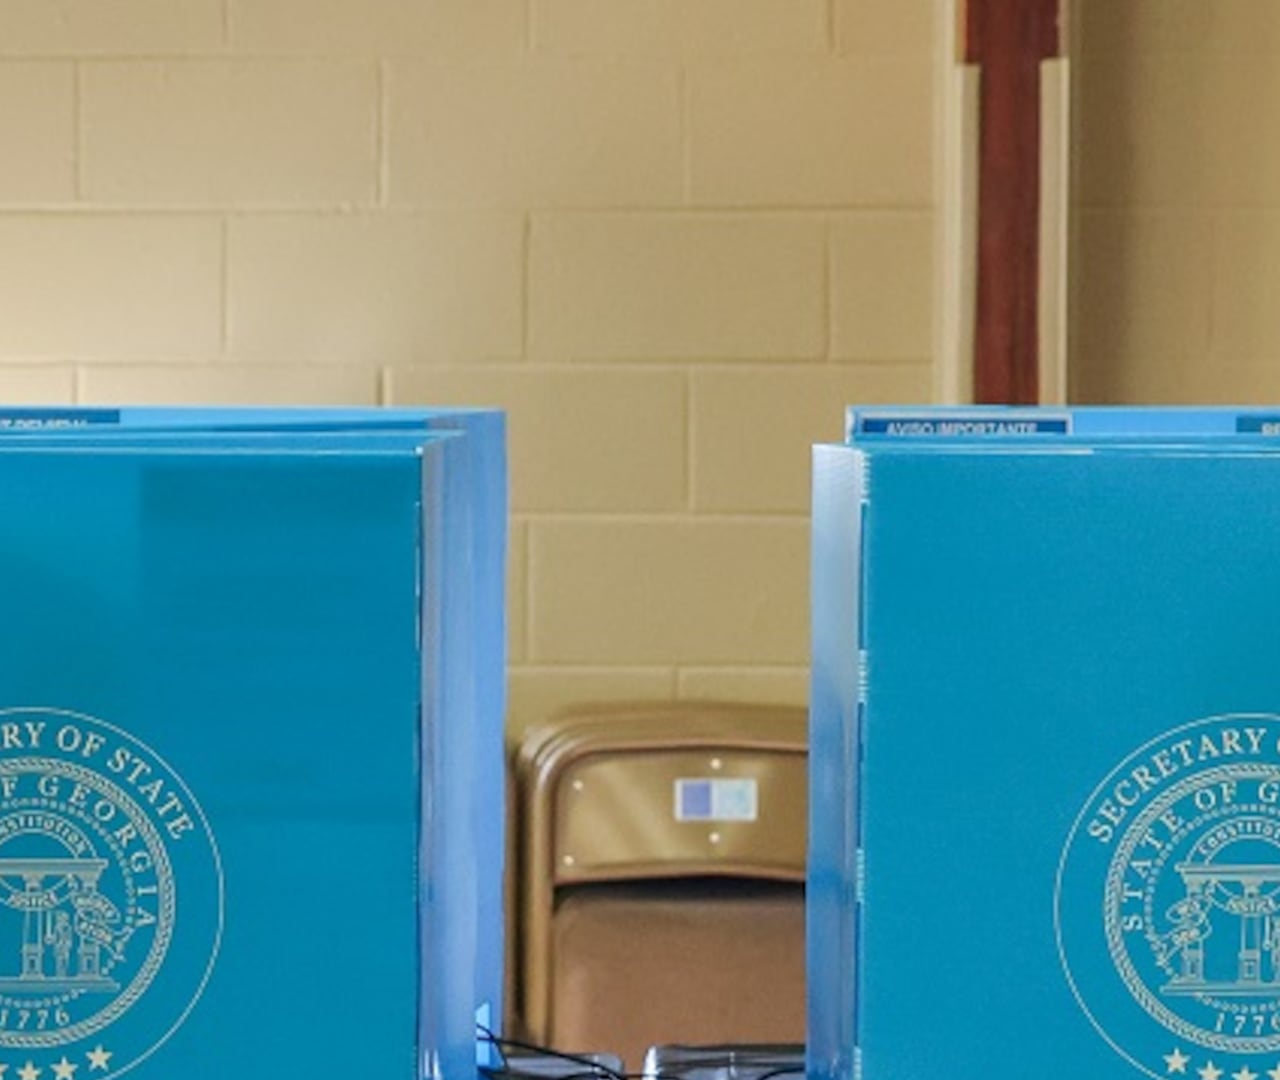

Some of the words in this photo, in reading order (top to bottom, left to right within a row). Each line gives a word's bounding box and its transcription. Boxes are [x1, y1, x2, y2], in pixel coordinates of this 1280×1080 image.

[886, 421, 934, 436] AVISO
[936, 421, 1038, 436] IMPORTANTE
[56, 724, 107, 759] OF
[106, 748, 195, 840] STATE
[1087, 727, 1267, 844] SECRETARY
[37, 775, 158, 929] GEORGIA
[1122, 810, 1185, 932] STATE
[1194, 782, 1238, 812] OF
